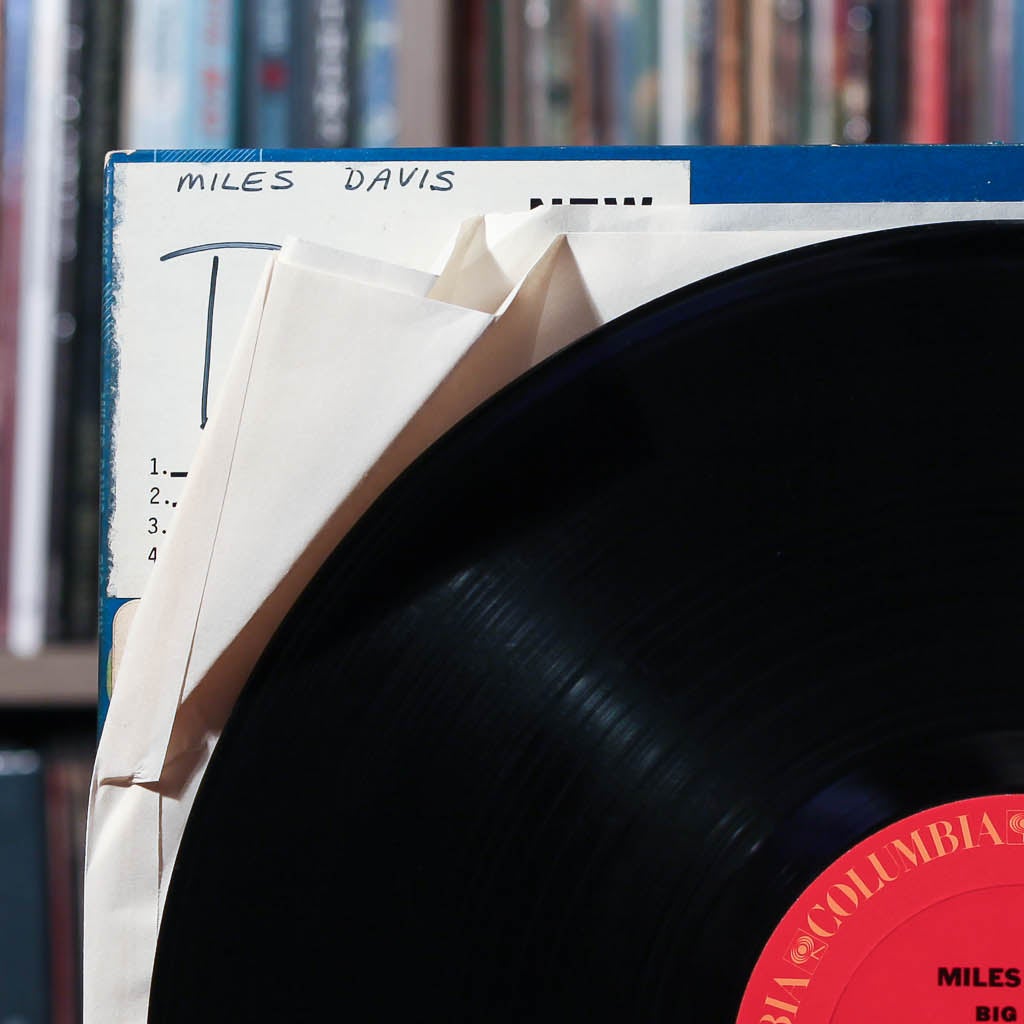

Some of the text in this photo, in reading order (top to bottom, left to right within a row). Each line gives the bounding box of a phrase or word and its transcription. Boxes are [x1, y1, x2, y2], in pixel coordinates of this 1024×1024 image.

[177, 167, 455, 192] MILES DAVIS
[148, 518, 166, 534] 3.
[807, 811, 1005, 938] COLUMBIA
[937, 967, 1022, 988] MILES
[975, 1005, 1018, 1023] BIG
